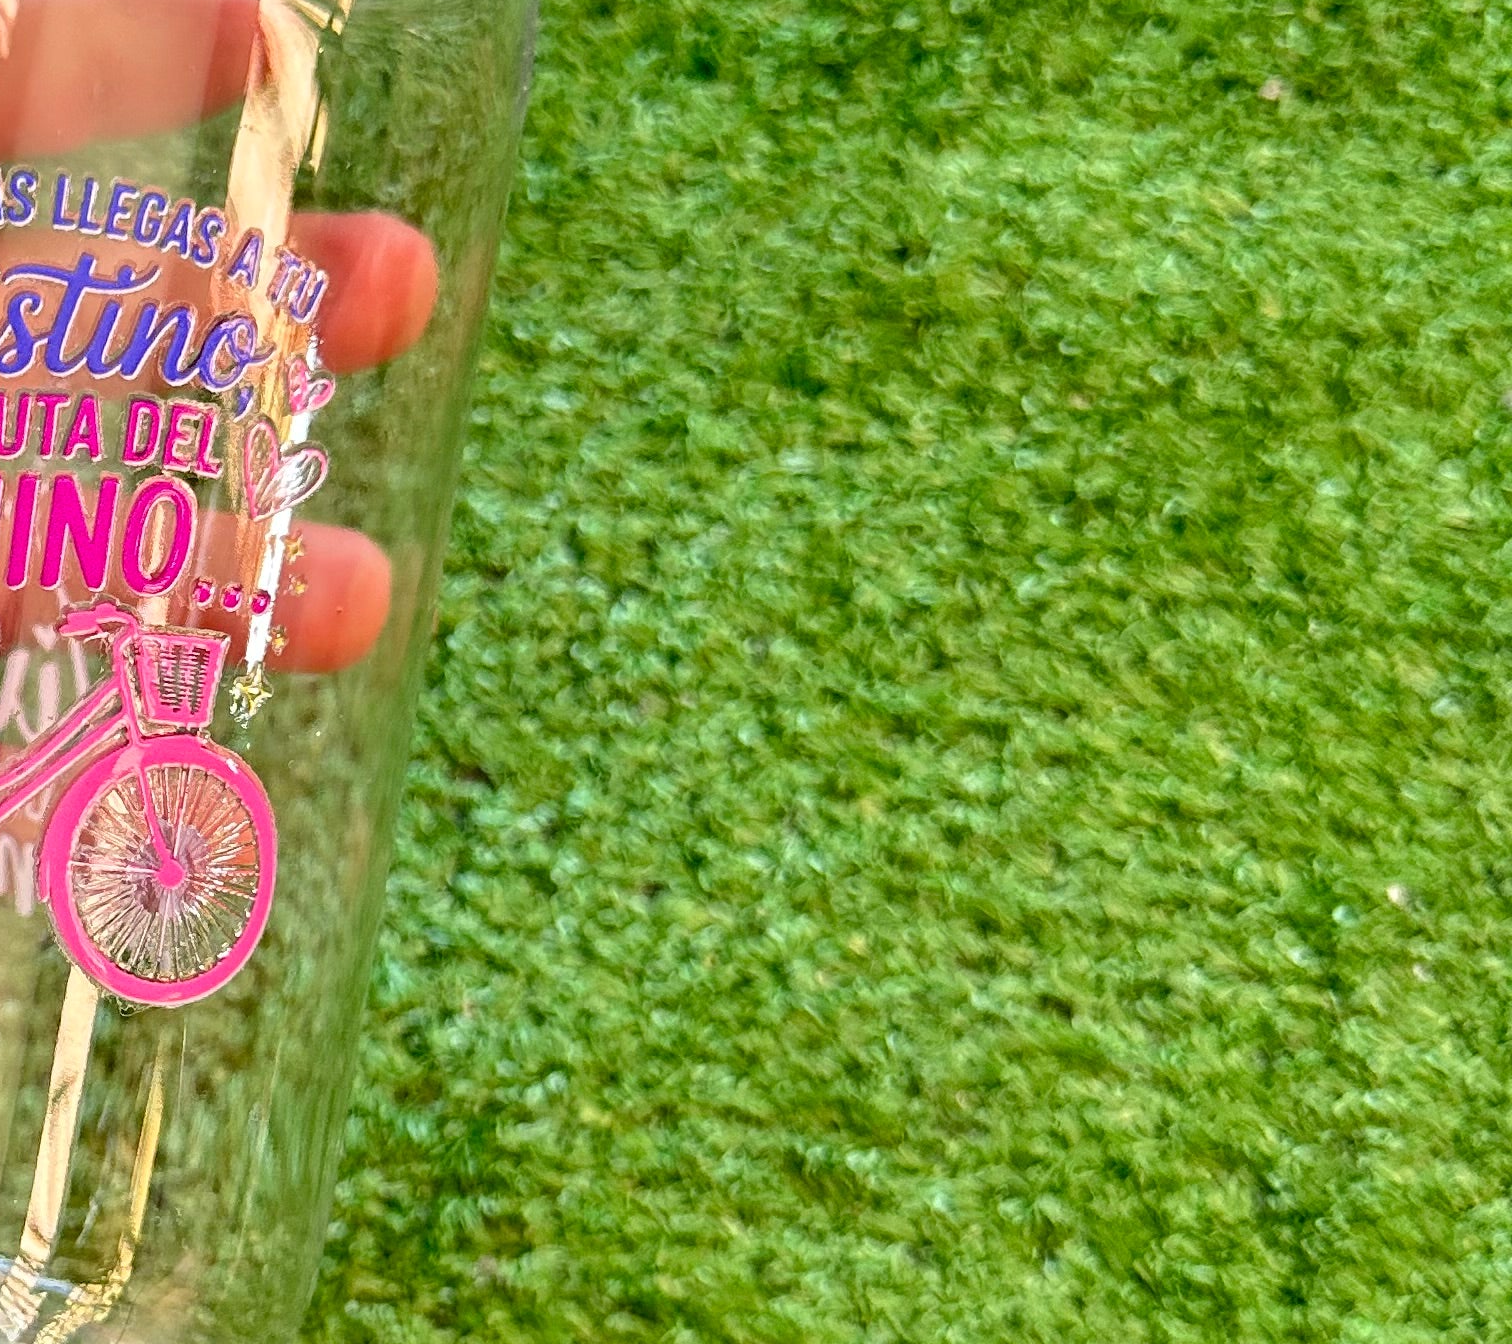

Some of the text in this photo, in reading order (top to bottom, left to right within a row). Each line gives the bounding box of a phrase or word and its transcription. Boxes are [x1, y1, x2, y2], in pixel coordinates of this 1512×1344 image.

[52, 174, 227, 268] LLEGAS
[227, 230, 263, 290] A
[268, 248, 329, 323] TU
[123, 393, 224, 479] DEL
